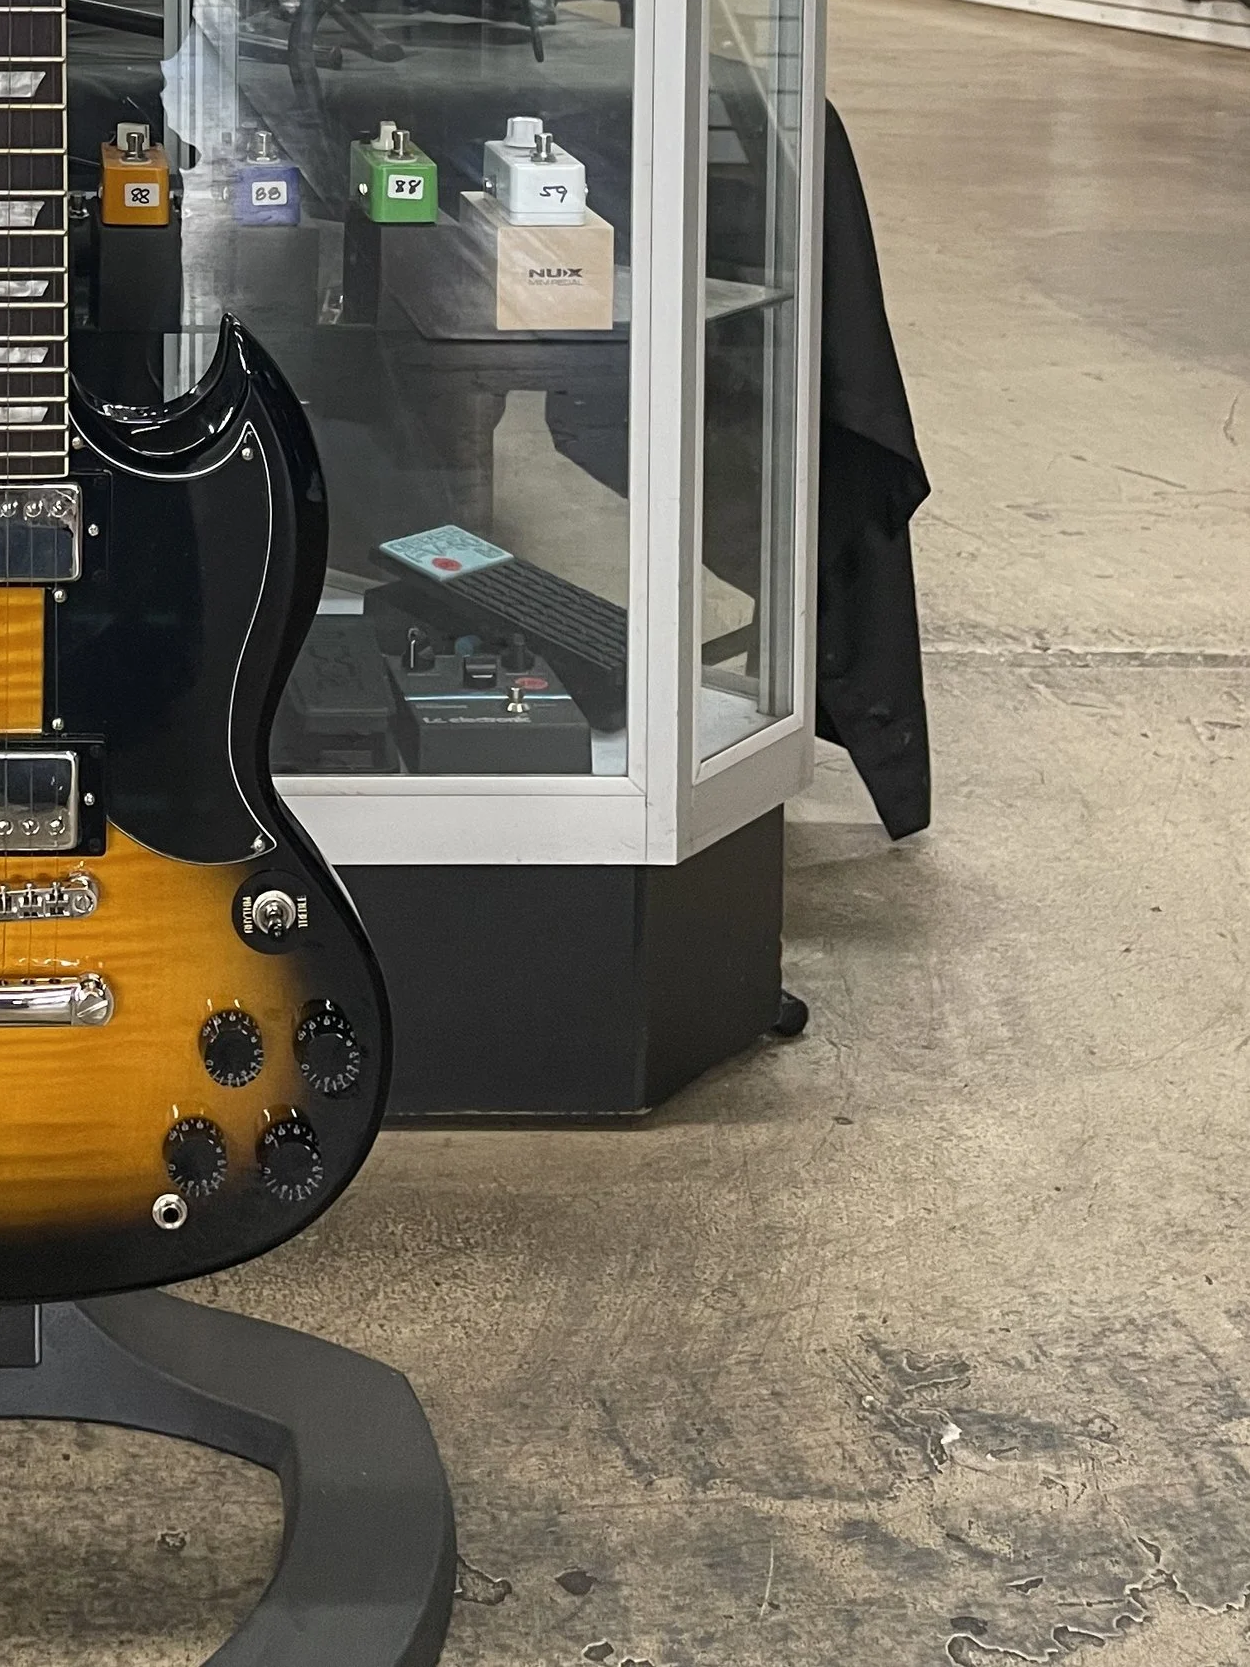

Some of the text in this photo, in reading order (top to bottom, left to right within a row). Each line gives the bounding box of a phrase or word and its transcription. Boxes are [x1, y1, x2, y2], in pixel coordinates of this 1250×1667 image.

[255, 186, 282, 201] 88
[539, 185, 568, 203] 59
[529, 268, 583, 278] NUX
